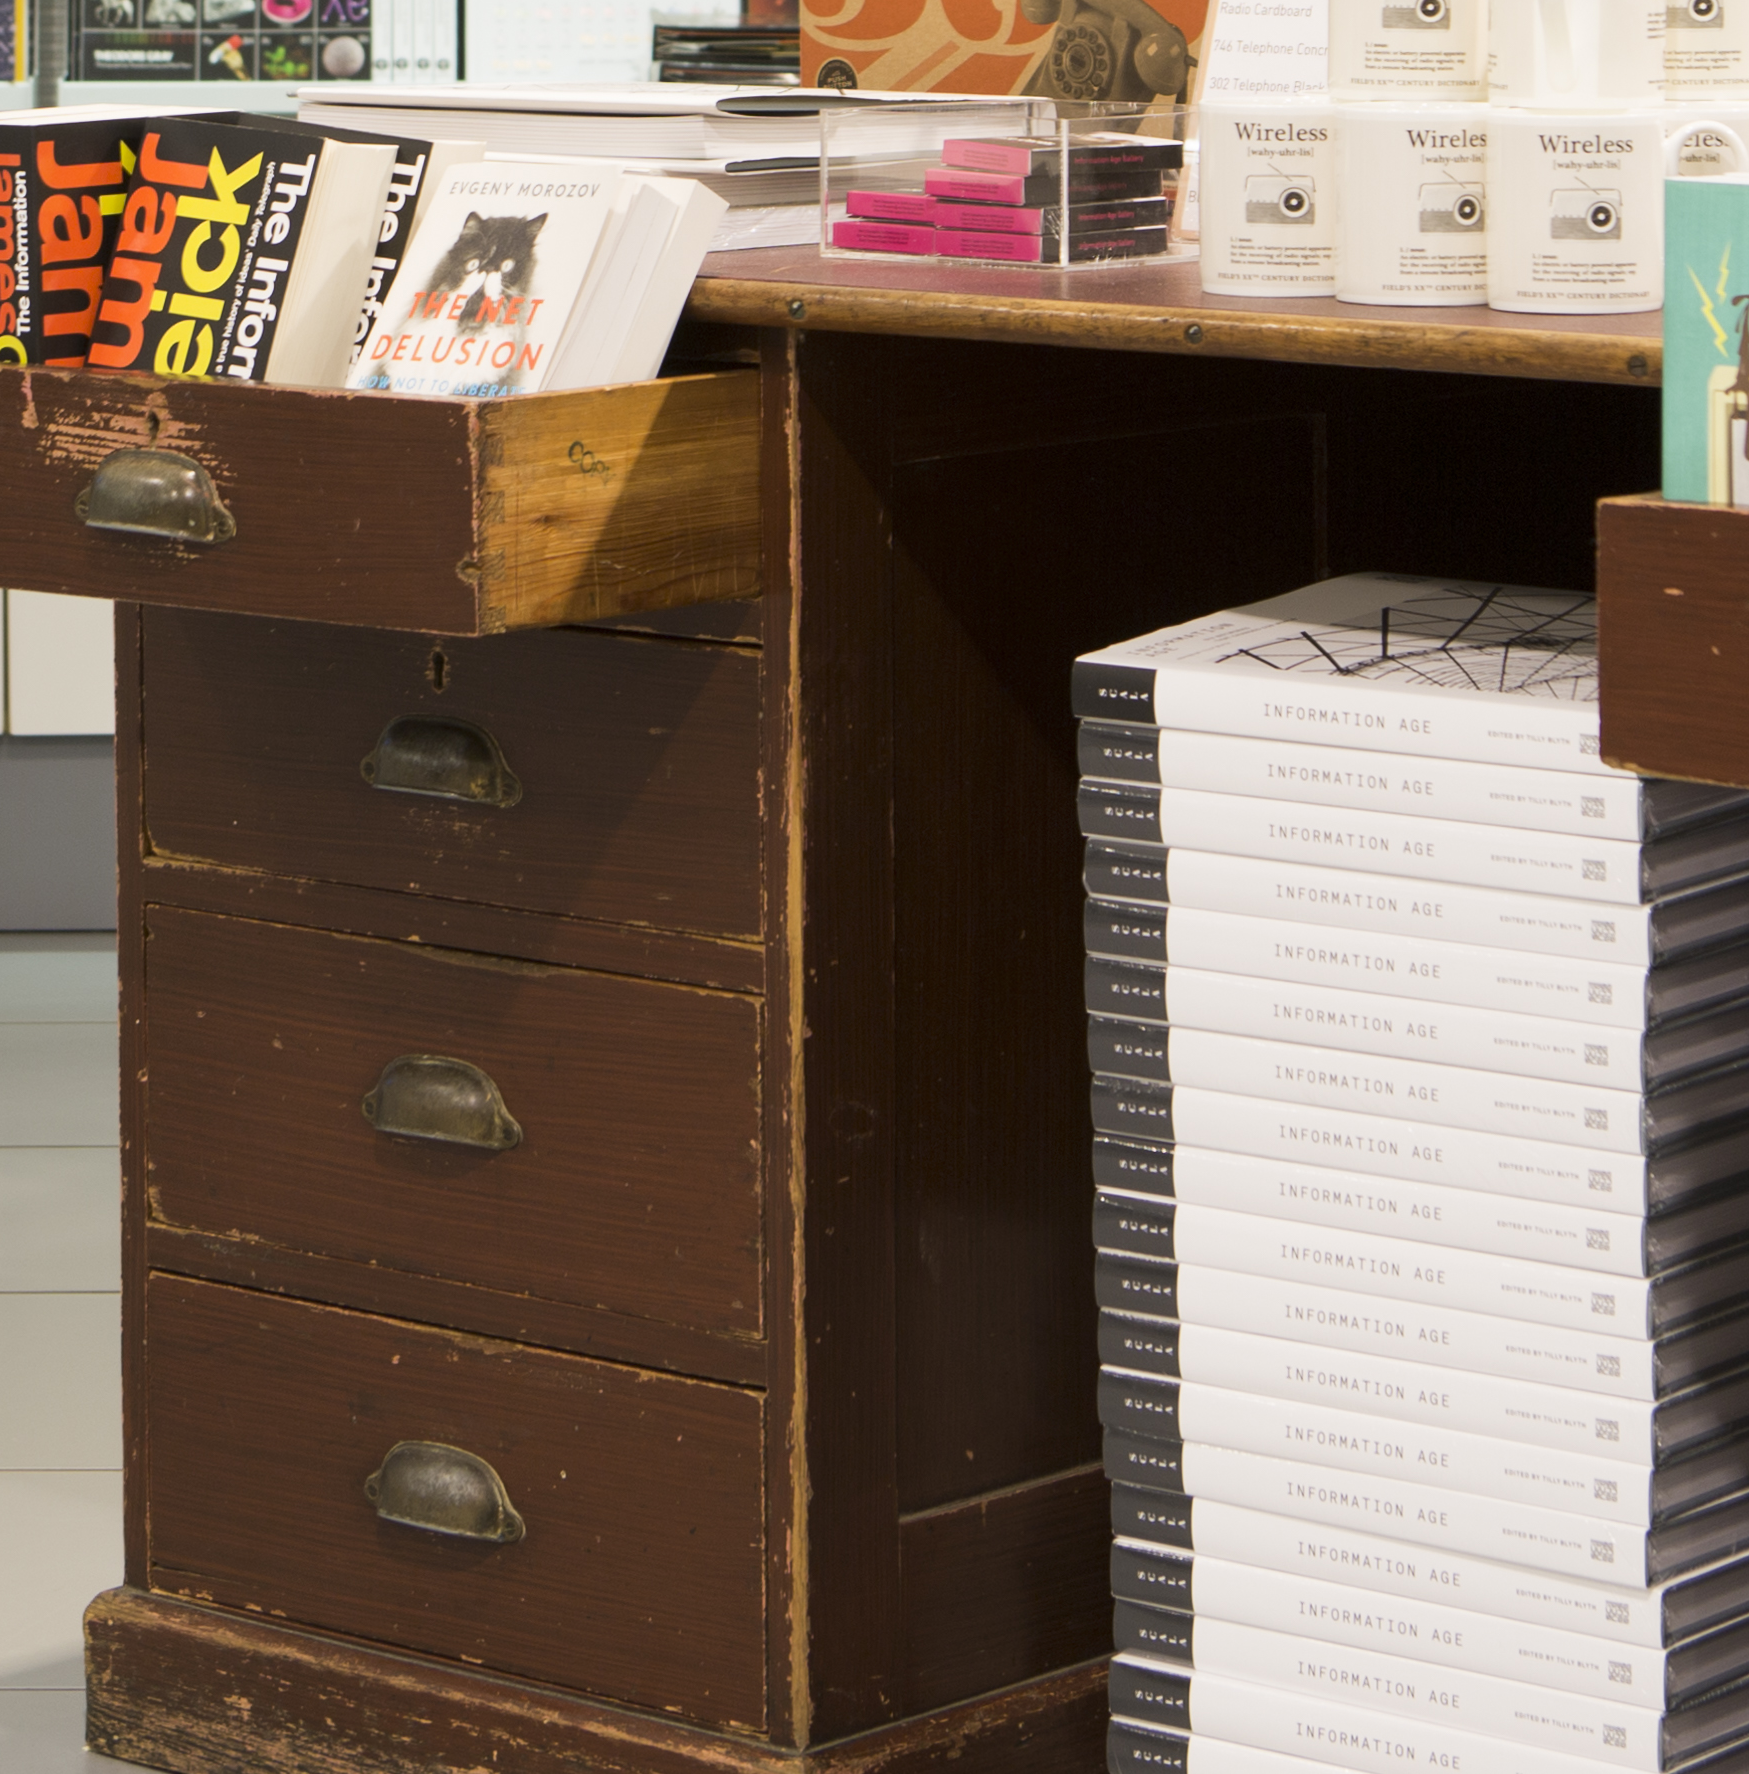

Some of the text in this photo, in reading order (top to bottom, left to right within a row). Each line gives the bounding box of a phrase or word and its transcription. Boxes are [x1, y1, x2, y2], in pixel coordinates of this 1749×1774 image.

[1220, 1, 1313, 18] Radio Cardboard
[1213, 39, 1233, 53] 746
[1236, 39, 1294, 57] Telephone
[1209, 76, 1229, 90] 302
[1233, 76, 1292, 93] Telephone
[1234, 122, 1329, 142] Wireless
[1538, 134, 1634, 154] Wireless
[264, 151, 316, 246] The
[449, 180, 602, 199] EVGENY MOROZOV
[13, 169, 31, 337] The Information
[407, 290, 546, 327] THE NET
[370, 334, 545, 372] DELUSION
[356, 375, 391, 389] HOW
[393, 376, 427, 392] NOT
[429, 378, 450, 393] TO
[1098, 687, 1433, 735] SCALA INFORMATION AGE
[1103, 747, 1154, 761] SCALA
[1267, 764, 1388, 790] INFORMATION
[1402, 779, 1435, 796] AGE
[1274, 943, 1442, 979] INFORMATION AGE
[1299, 1601, 1464, 1648] INFORMATION AGE
